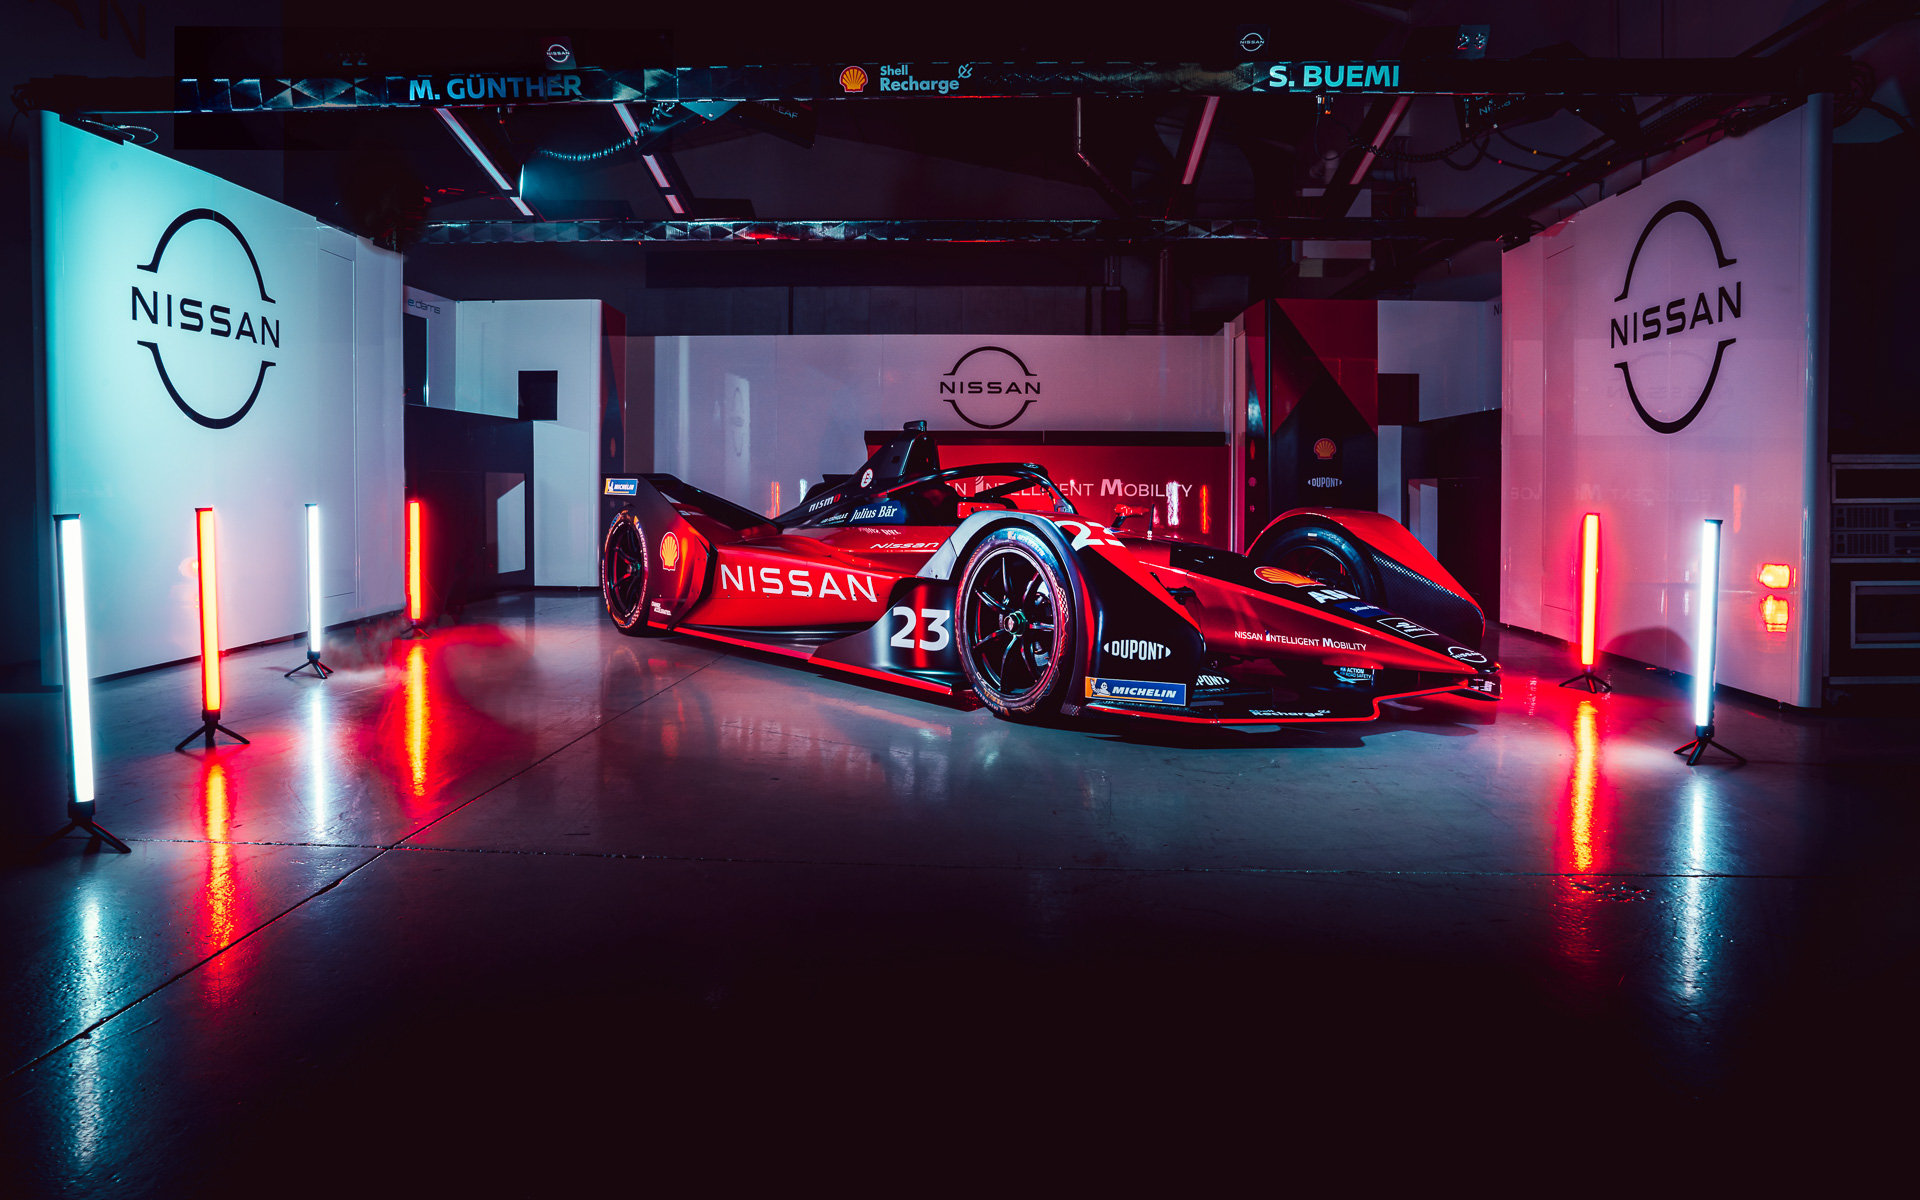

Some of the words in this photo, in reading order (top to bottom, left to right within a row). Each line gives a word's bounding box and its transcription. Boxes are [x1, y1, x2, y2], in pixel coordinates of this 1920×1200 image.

[880, 65, 908, 76] Shell
[1269, 65, 1295, 87] S.
[1303, 65, 1400, 87] BUEMI
[409, 79, 441, 101] M.
[447, 74, 582, 100] GÜNTHER
[880, 76, 960, 94] Recharge
[131, 286, 280, 348] NISSAN
[1611, 281, 1742, 349] NISSAN
[940, 381, 1041, 394] NISSAN
[1311, 477, 1339, 488] DUPONT
[847, 508, 878, 523] Julius
[878, 505, 899, 518] Bär
[721, 564, 878, 602] NISSAN
[890, 606, 950, 651] 23
[1111, 639, 1165, 661] DUPONT
[1234, 631, 1263, 641] NISSAN
[1265, 630, 1320, 647] INTELLIGENT
[1322, 637, 1367, 651] MOBILITY
[1195, 675, 1225, 686] PONT
[1112, 686, 1177, 698] MICHELIN
